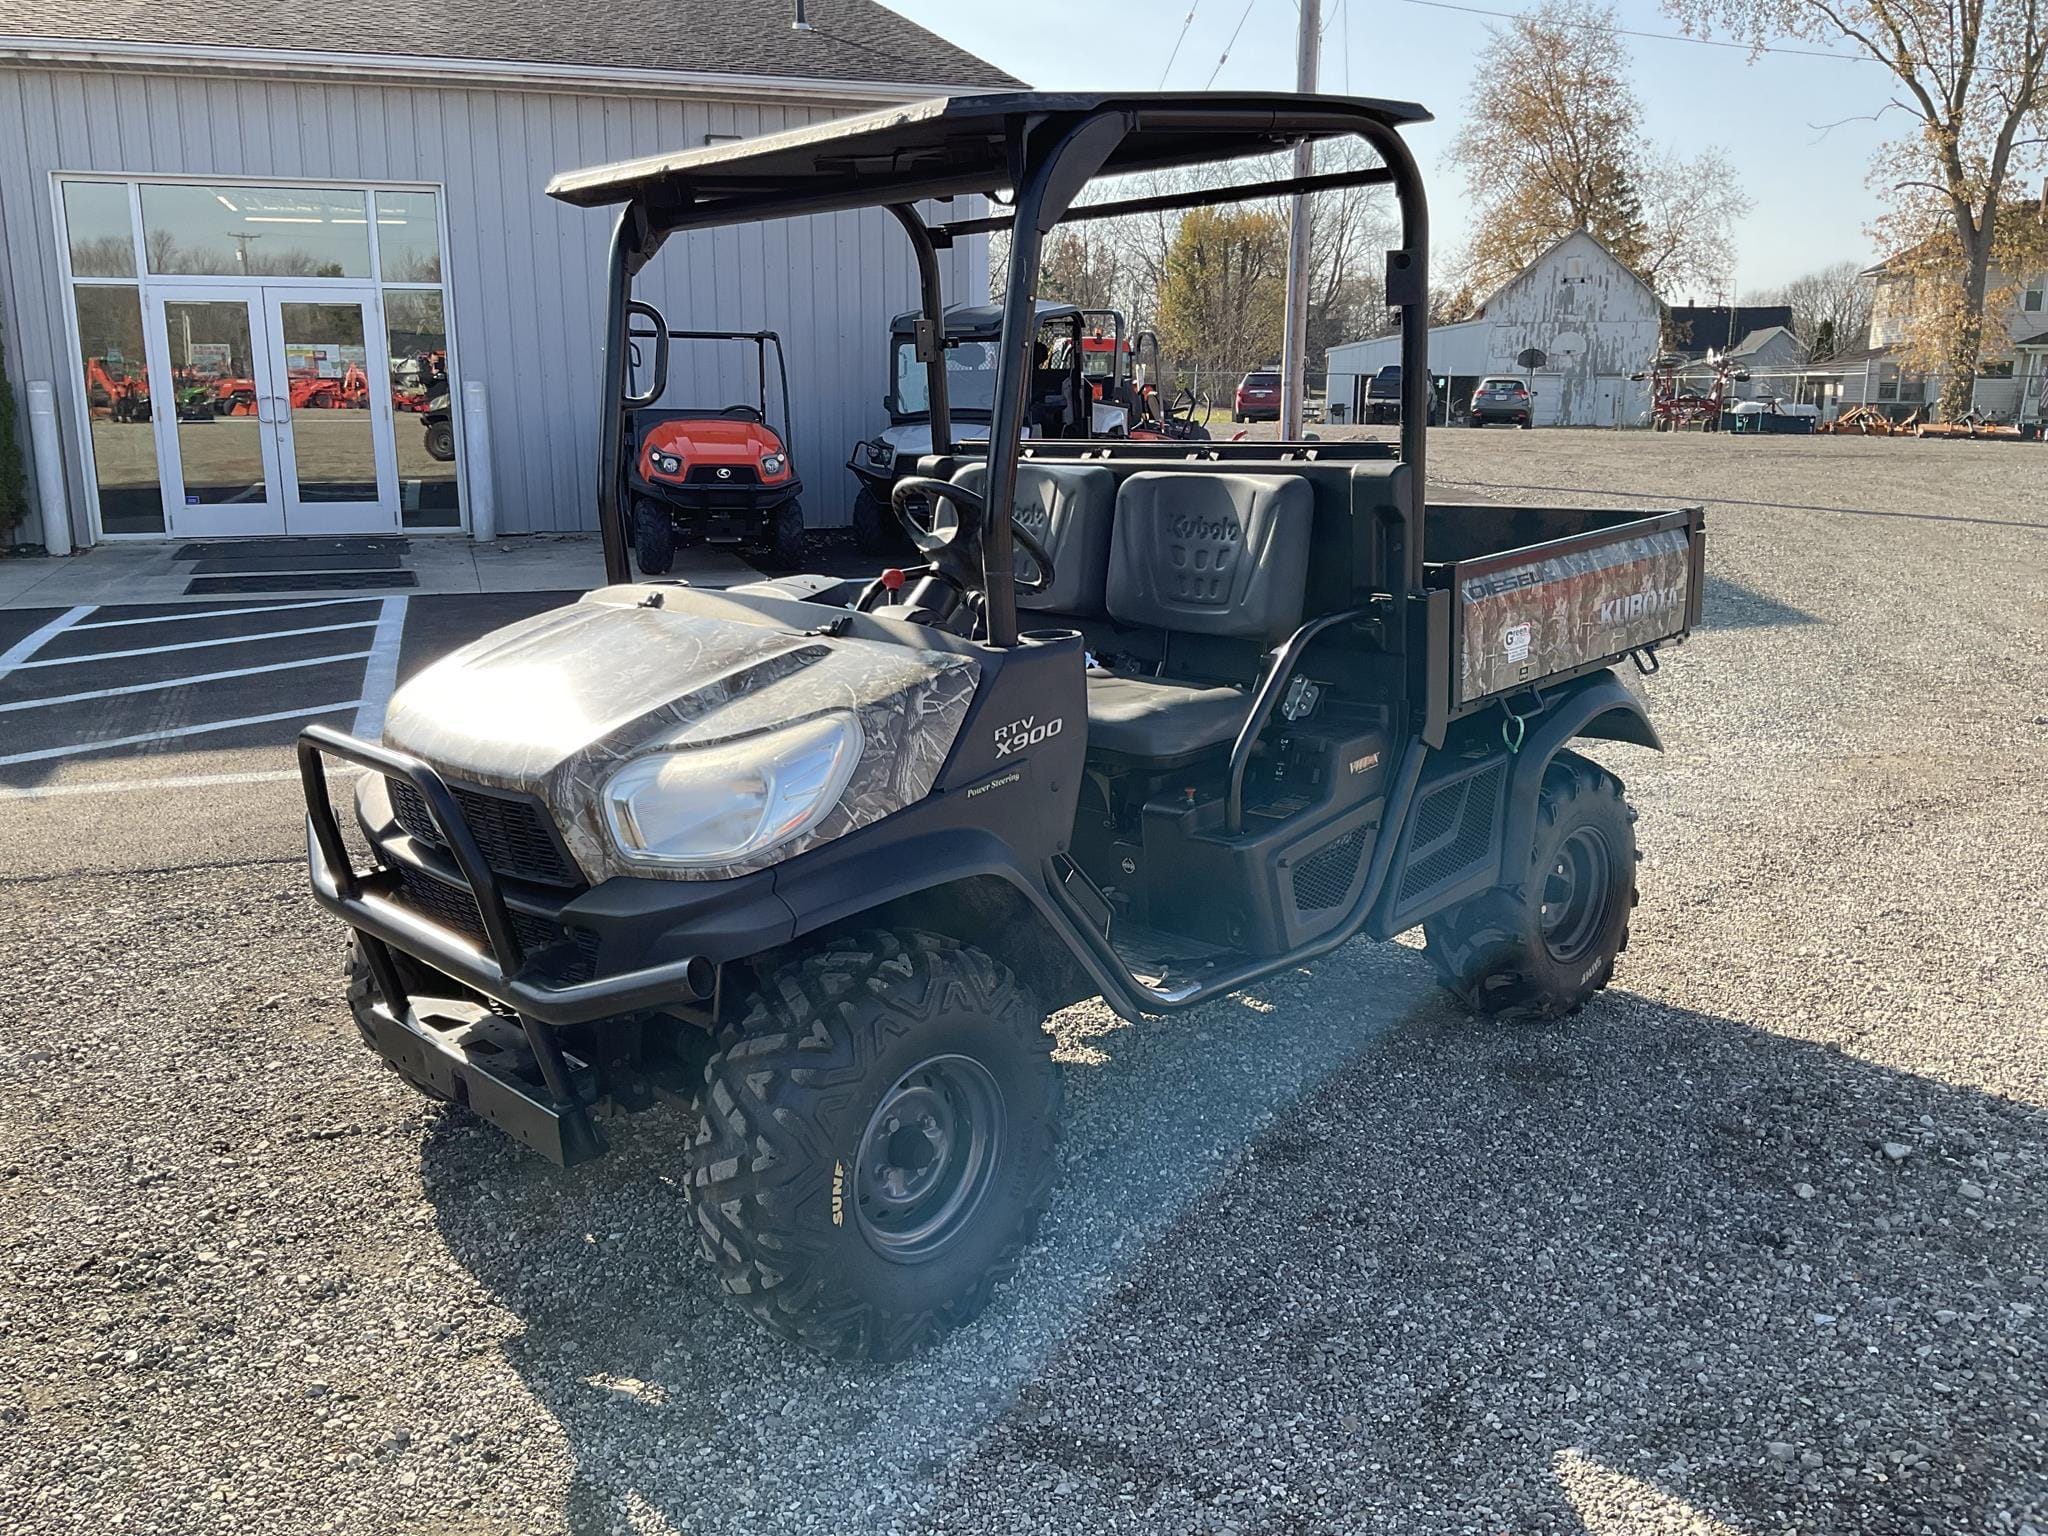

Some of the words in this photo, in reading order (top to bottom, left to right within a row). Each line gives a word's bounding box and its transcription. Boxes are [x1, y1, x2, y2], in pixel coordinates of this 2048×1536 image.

[1468, 571, 1544, 601] DIESEL
[1600, 588, 1678, 630] KUBOTA
[994, 715, 1034, 741] RTV
[995, 718, 1062, 759] X900
[967, 784, 991, 798] Power
[991, 772, 1020, 790] Steering
[832, 1159, 844, 1228] SUNF
